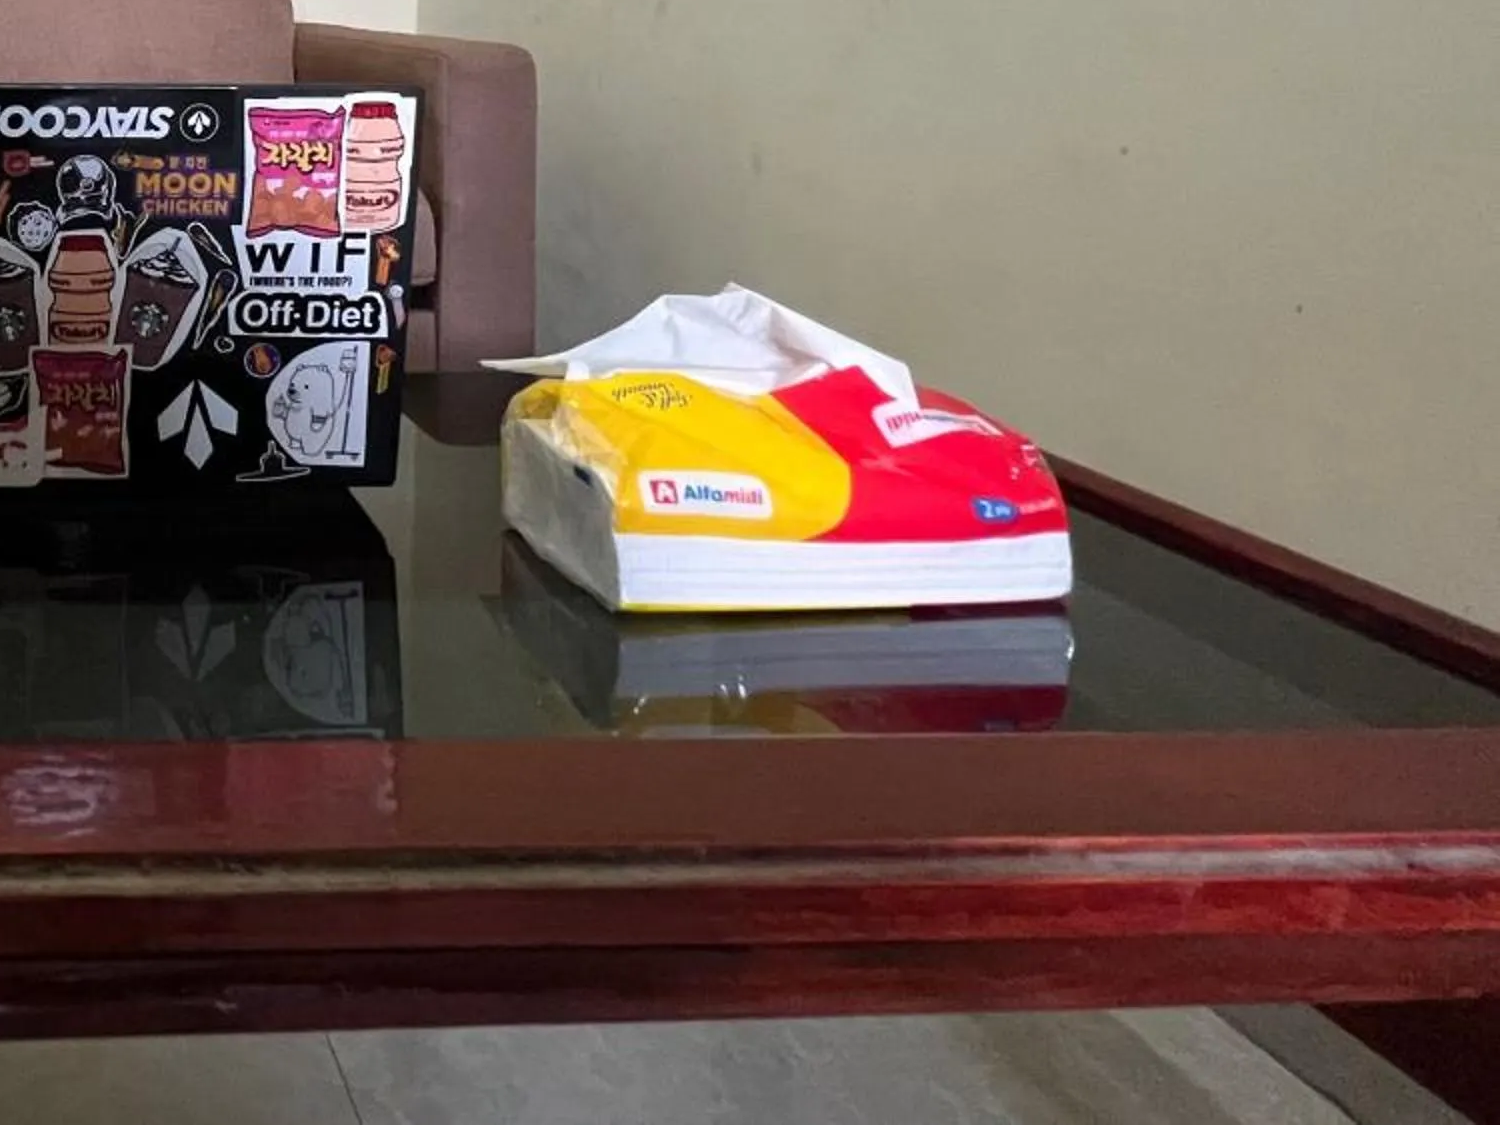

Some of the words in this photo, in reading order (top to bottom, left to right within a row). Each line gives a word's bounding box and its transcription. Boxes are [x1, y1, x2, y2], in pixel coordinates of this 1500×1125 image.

[136, 172, 237, 197] MOON
[143, 199, 229, 216] CHICKEN
[298, 276, 316, 288] THE
[684, 483, 763, 505] Alfamidi
